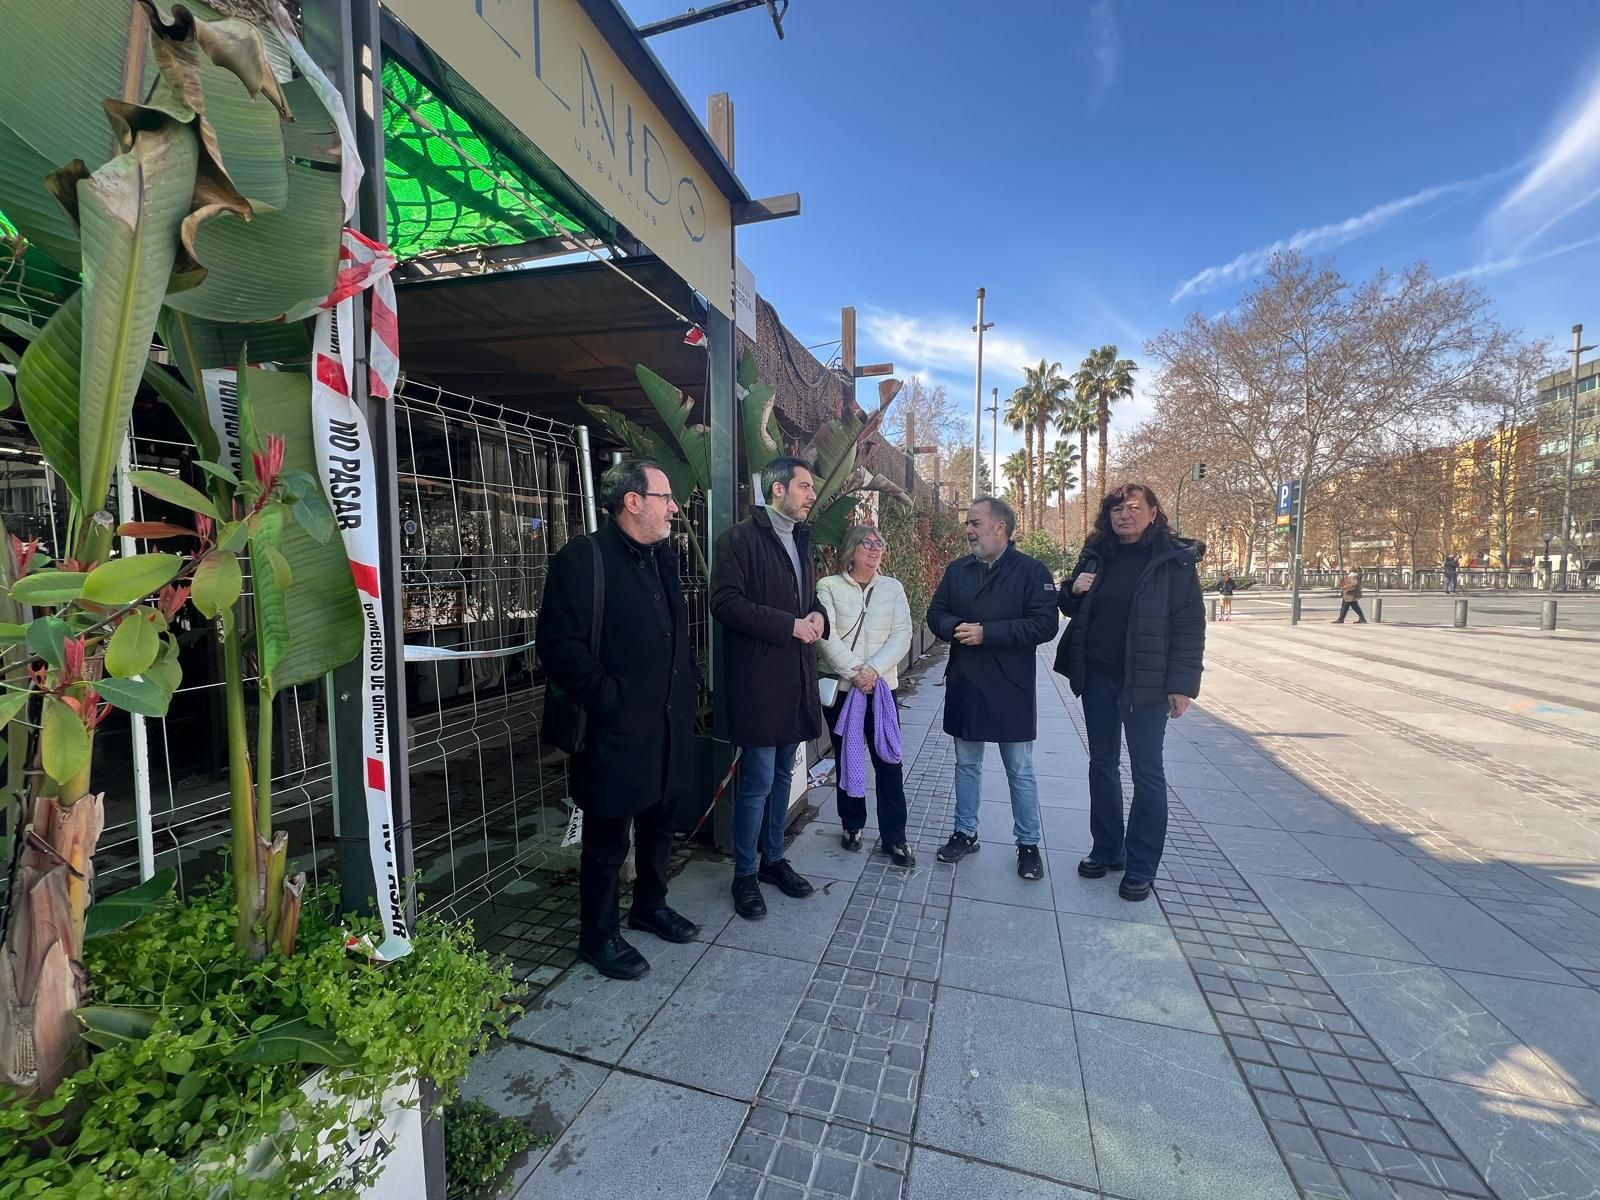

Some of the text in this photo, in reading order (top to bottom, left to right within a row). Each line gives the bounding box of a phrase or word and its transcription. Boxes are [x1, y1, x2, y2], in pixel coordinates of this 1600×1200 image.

[578, 43, 706, 242] NIDO
[329, 418, 361, 531] NO PASAR
